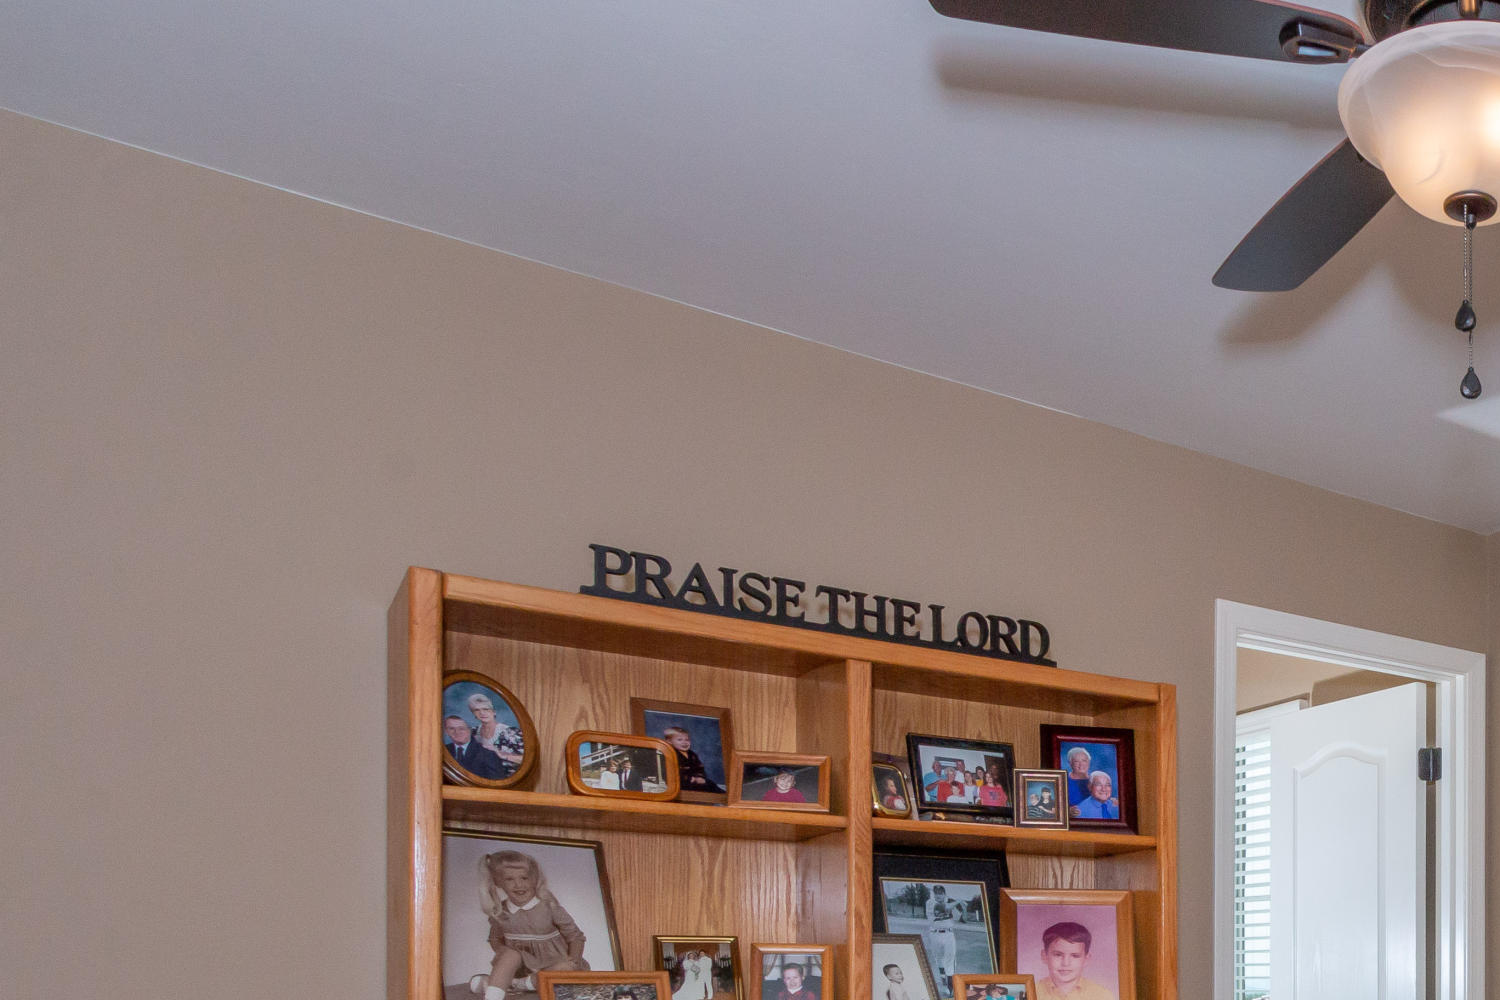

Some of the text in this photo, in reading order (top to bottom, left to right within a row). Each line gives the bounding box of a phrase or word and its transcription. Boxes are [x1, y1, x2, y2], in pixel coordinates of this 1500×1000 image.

[588, 543, 1055, 664] PRAISE THE LORD
